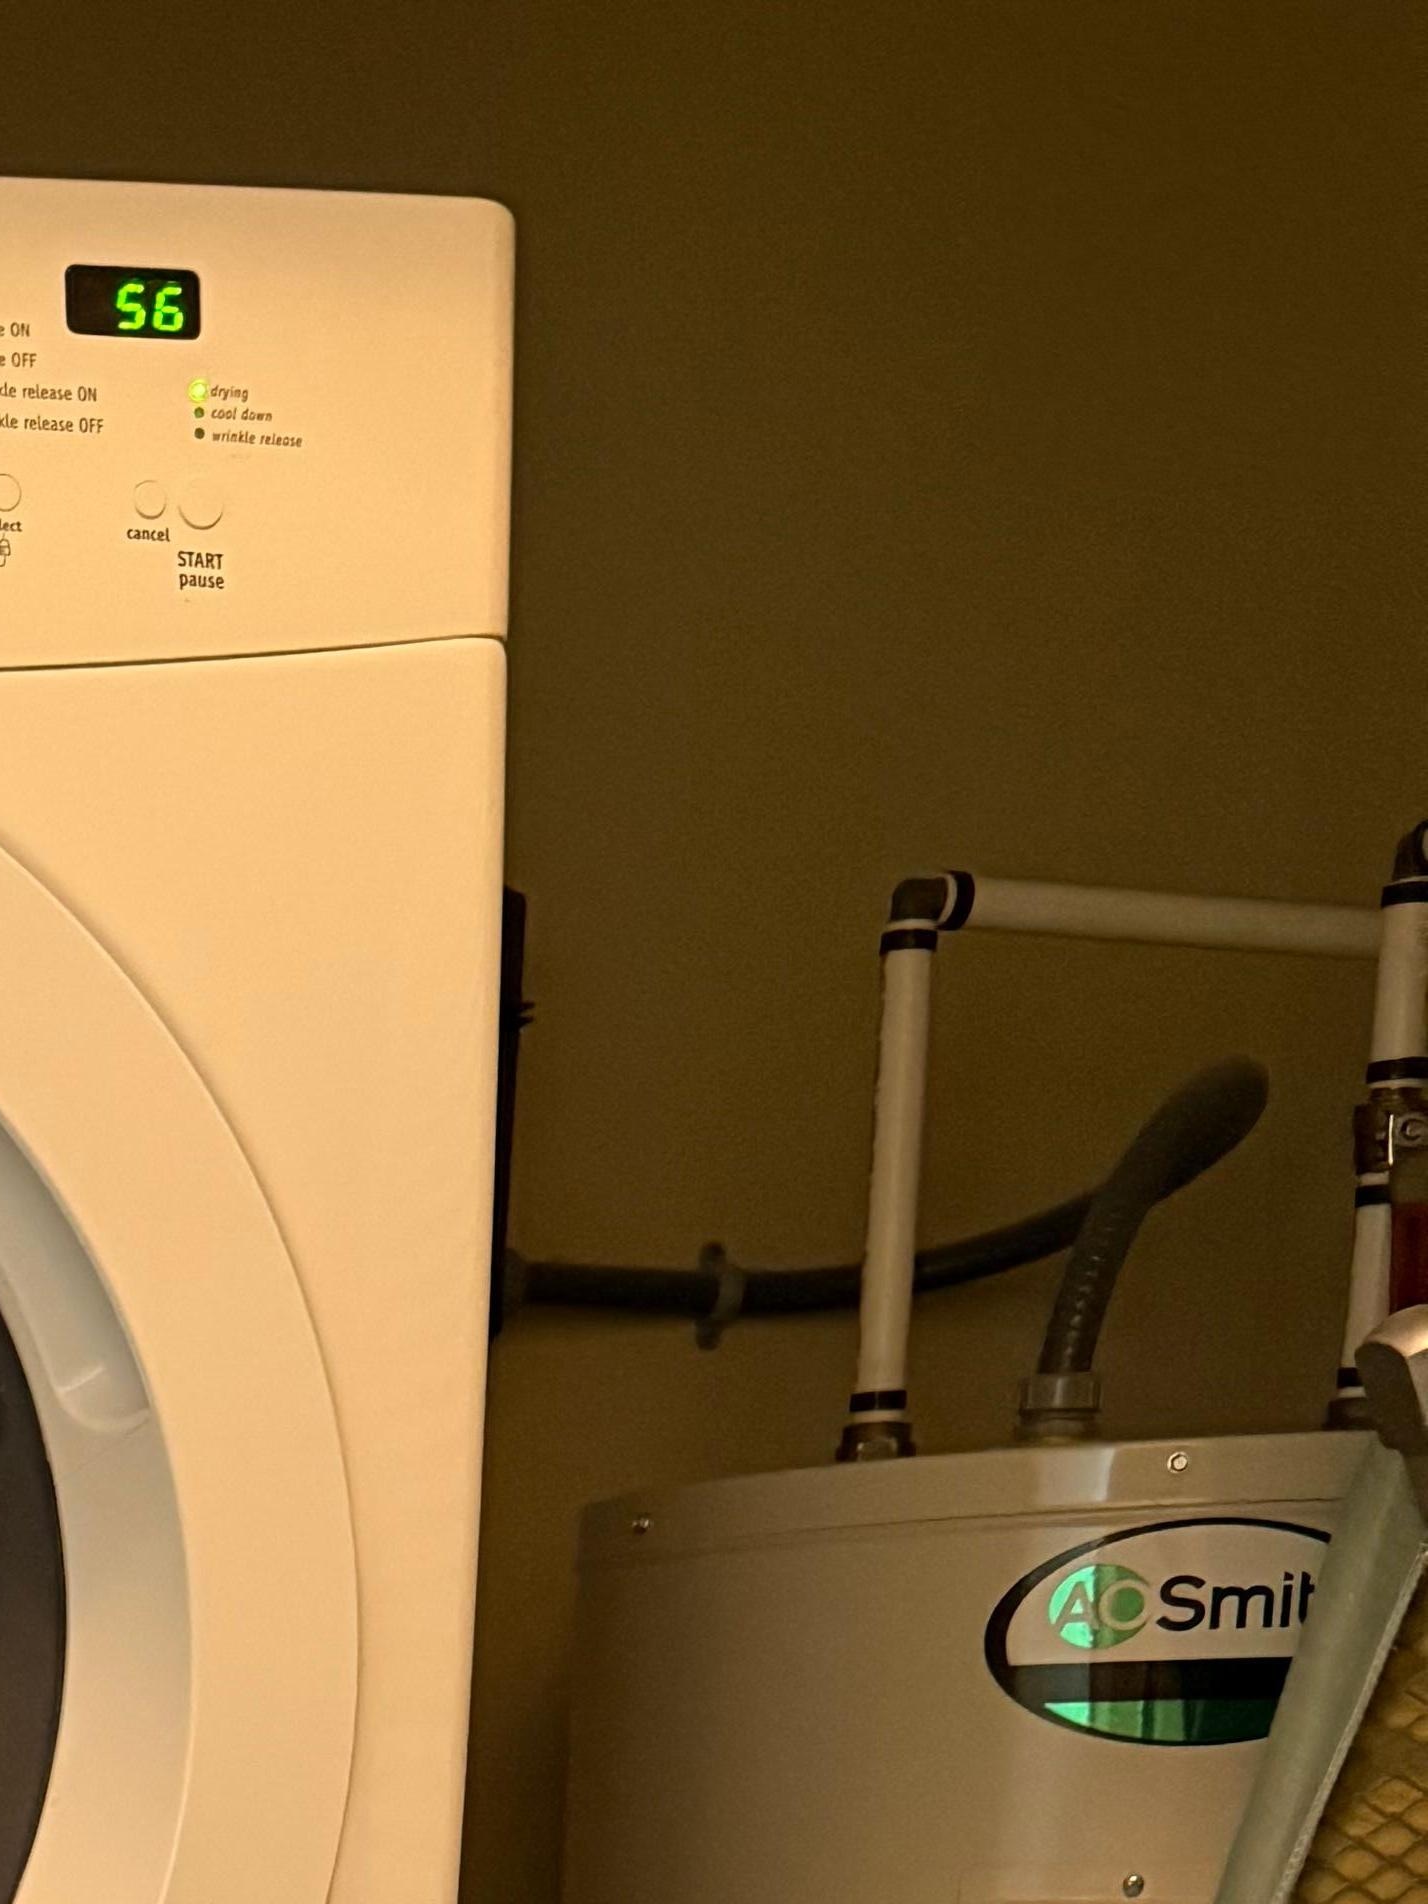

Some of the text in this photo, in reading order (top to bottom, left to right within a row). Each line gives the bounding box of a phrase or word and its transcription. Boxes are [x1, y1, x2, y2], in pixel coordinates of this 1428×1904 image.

[116, 283, 184, 331] 56
[10, 322, 30, 338] ON
[11, 353, 37, 369] OFF
[22, 384, 73, 402] release
[77, 386, 98, 402] ON
[210, 384, 249, 402] drying
[211, 407, 273, 422] cool down
[24, 415, 74, 433] release
[79, 417, 104, 434] OFF
[211, 430, 257, 446] wrinkle
[126, 525, 170, 544] cancel
[177, 550, 224, 571] START
[178, 572, 225, 590] pause
